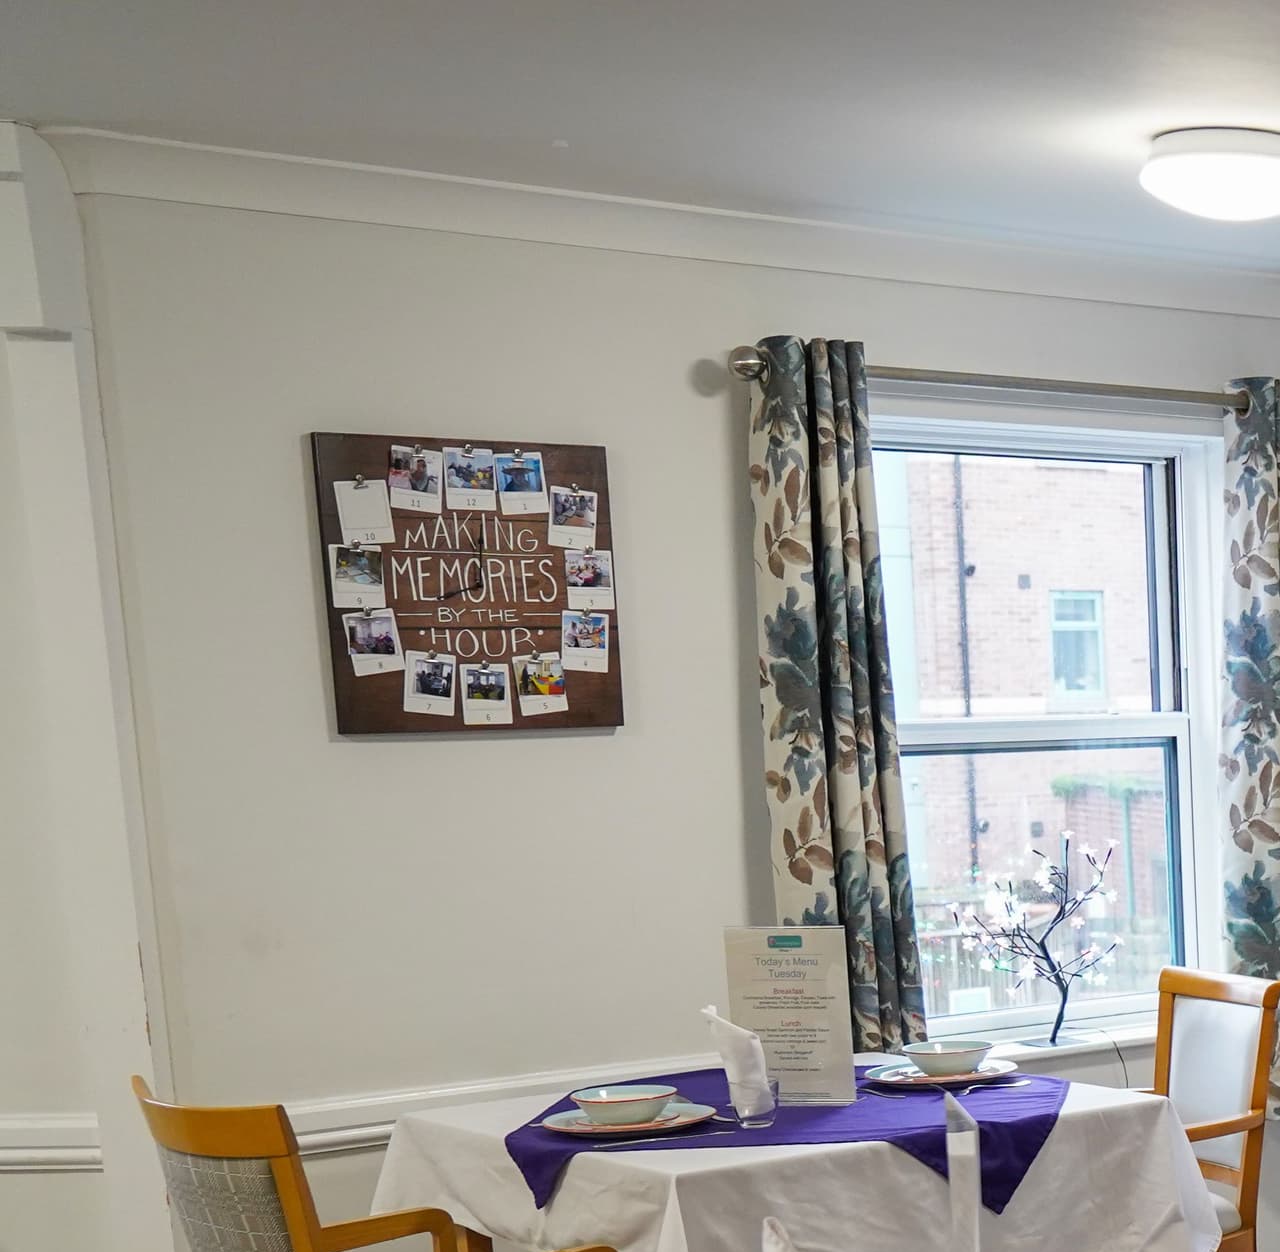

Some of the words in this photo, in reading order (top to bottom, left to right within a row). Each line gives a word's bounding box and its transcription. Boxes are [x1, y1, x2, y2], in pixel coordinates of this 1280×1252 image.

[411, 499, 421, 508] 11
[466, 498, 477, 507] 12
[404, 511, 539, 553] MAKING
[364, 532, 376, 542] 10
[391, 555, 558, 603] MEMORIES
[356, 596, 363, 605] 9
[437, 606, 467, 623] BY
[471, 608, 520, 623] THE
[430, 627, 537, 658] HOUR
[543, 702, 549, 711] 5
[486, 714, 492, 722] 6
[792, 957, 818, 966] Menu
[768, 968, 807, 980] Tuesday
